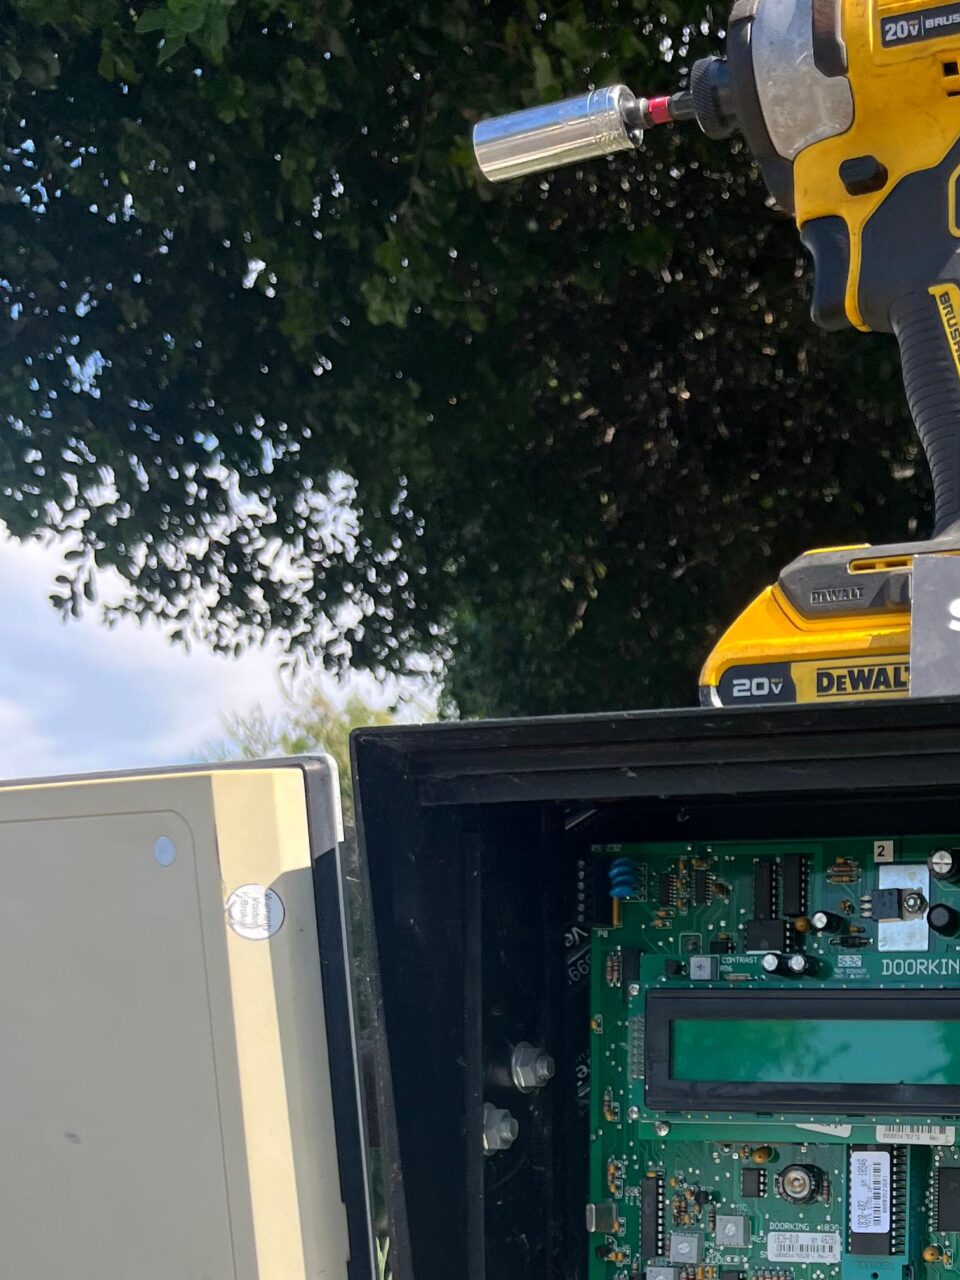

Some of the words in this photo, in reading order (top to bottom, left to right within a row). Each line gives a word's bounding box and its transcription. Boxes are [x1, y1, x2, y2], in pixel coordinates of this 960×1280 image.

[876, 845, 886, 858] 2
[721, 956, 758, 965] CONTRAST
[769, 1222, 810, 1231] DOORKING
